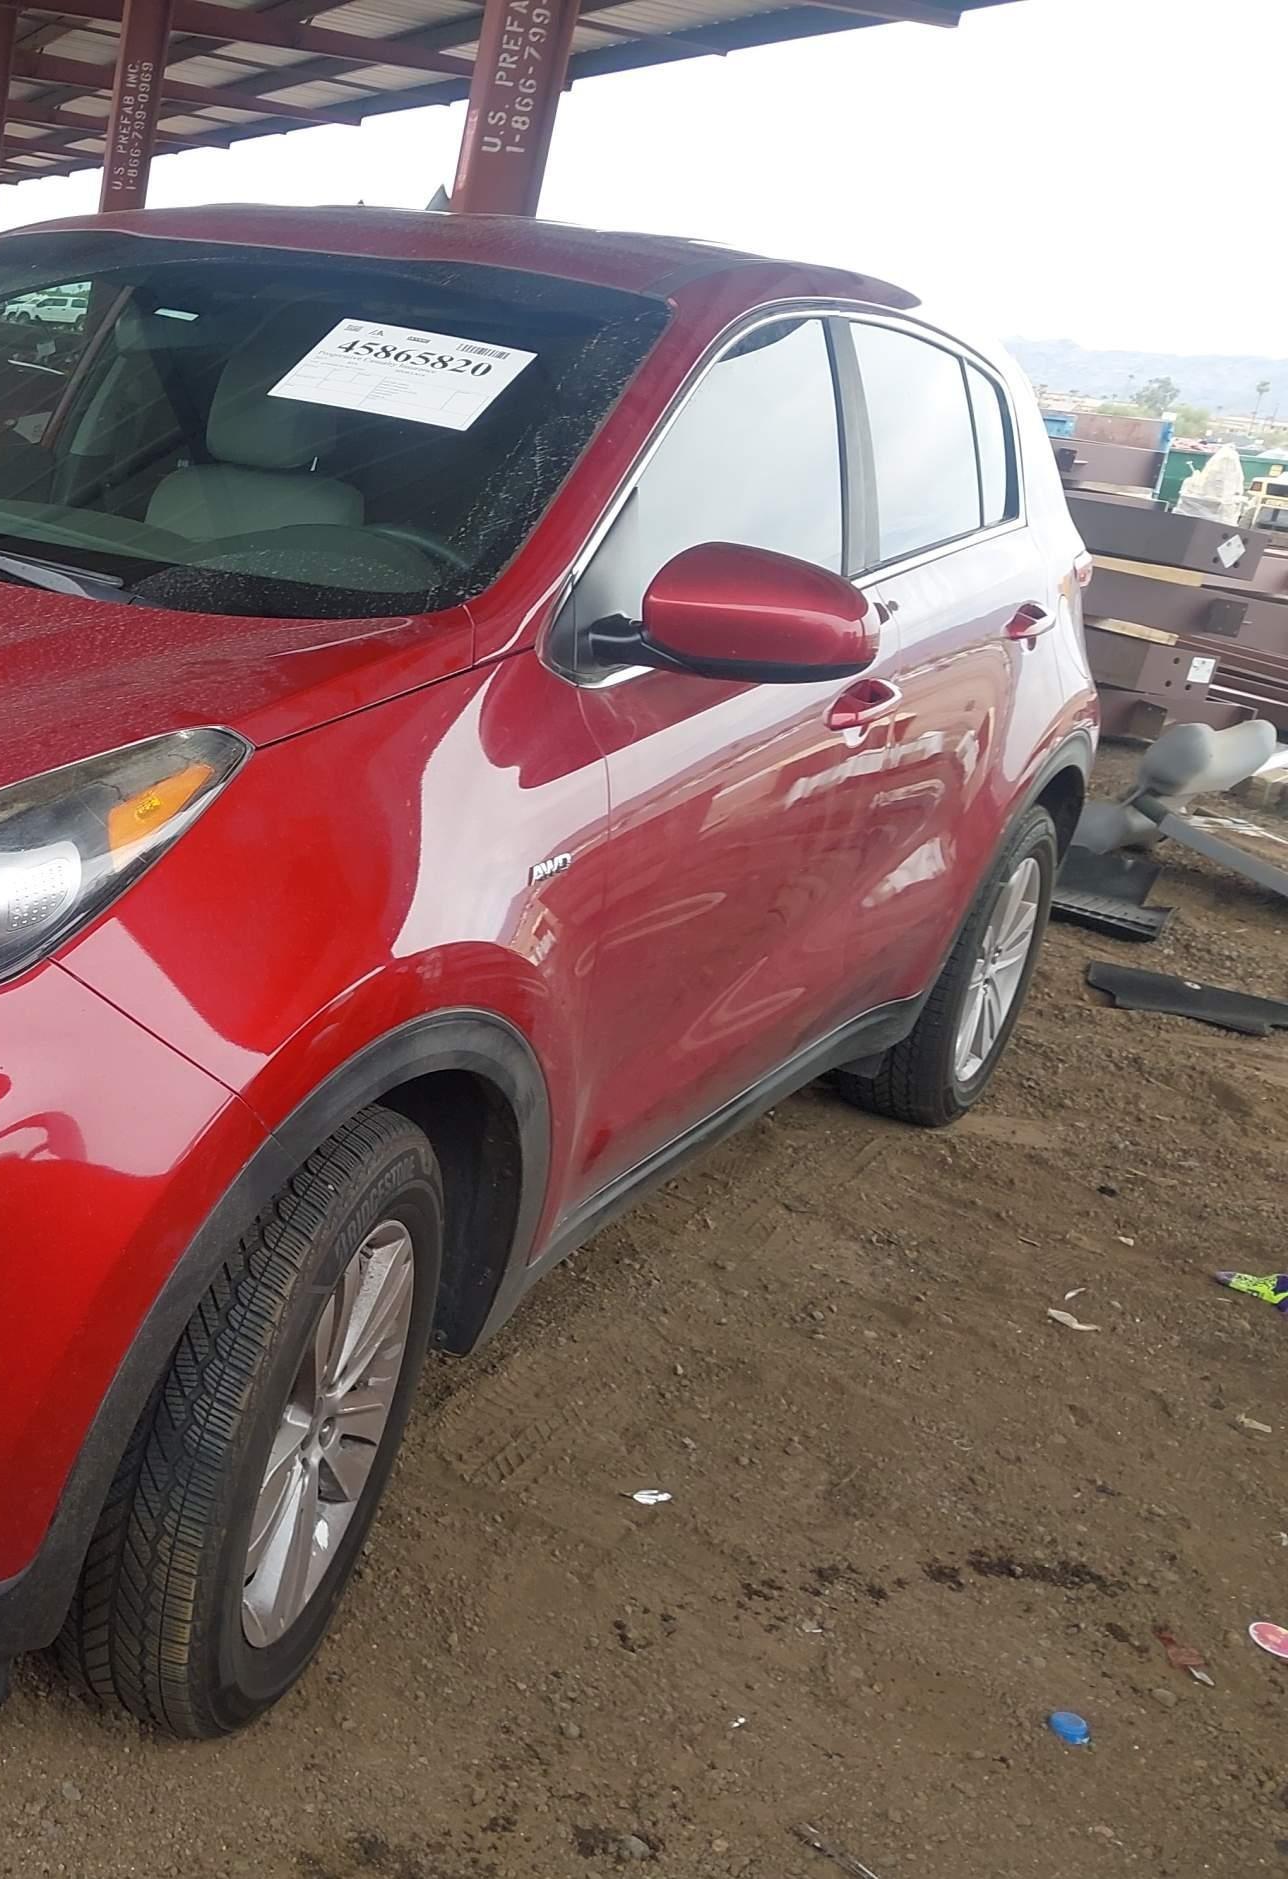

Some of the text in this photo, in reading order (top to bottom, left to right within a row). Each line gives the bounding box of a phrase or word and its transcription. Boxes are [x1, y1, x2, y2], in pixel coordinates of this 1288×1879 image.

[117, 95, 135, 154] PREFAB
[481, 103, 510, 153] U.S.
[337, 339, 493, 377] 45865820
[531, 852, 572, 881] AWD
